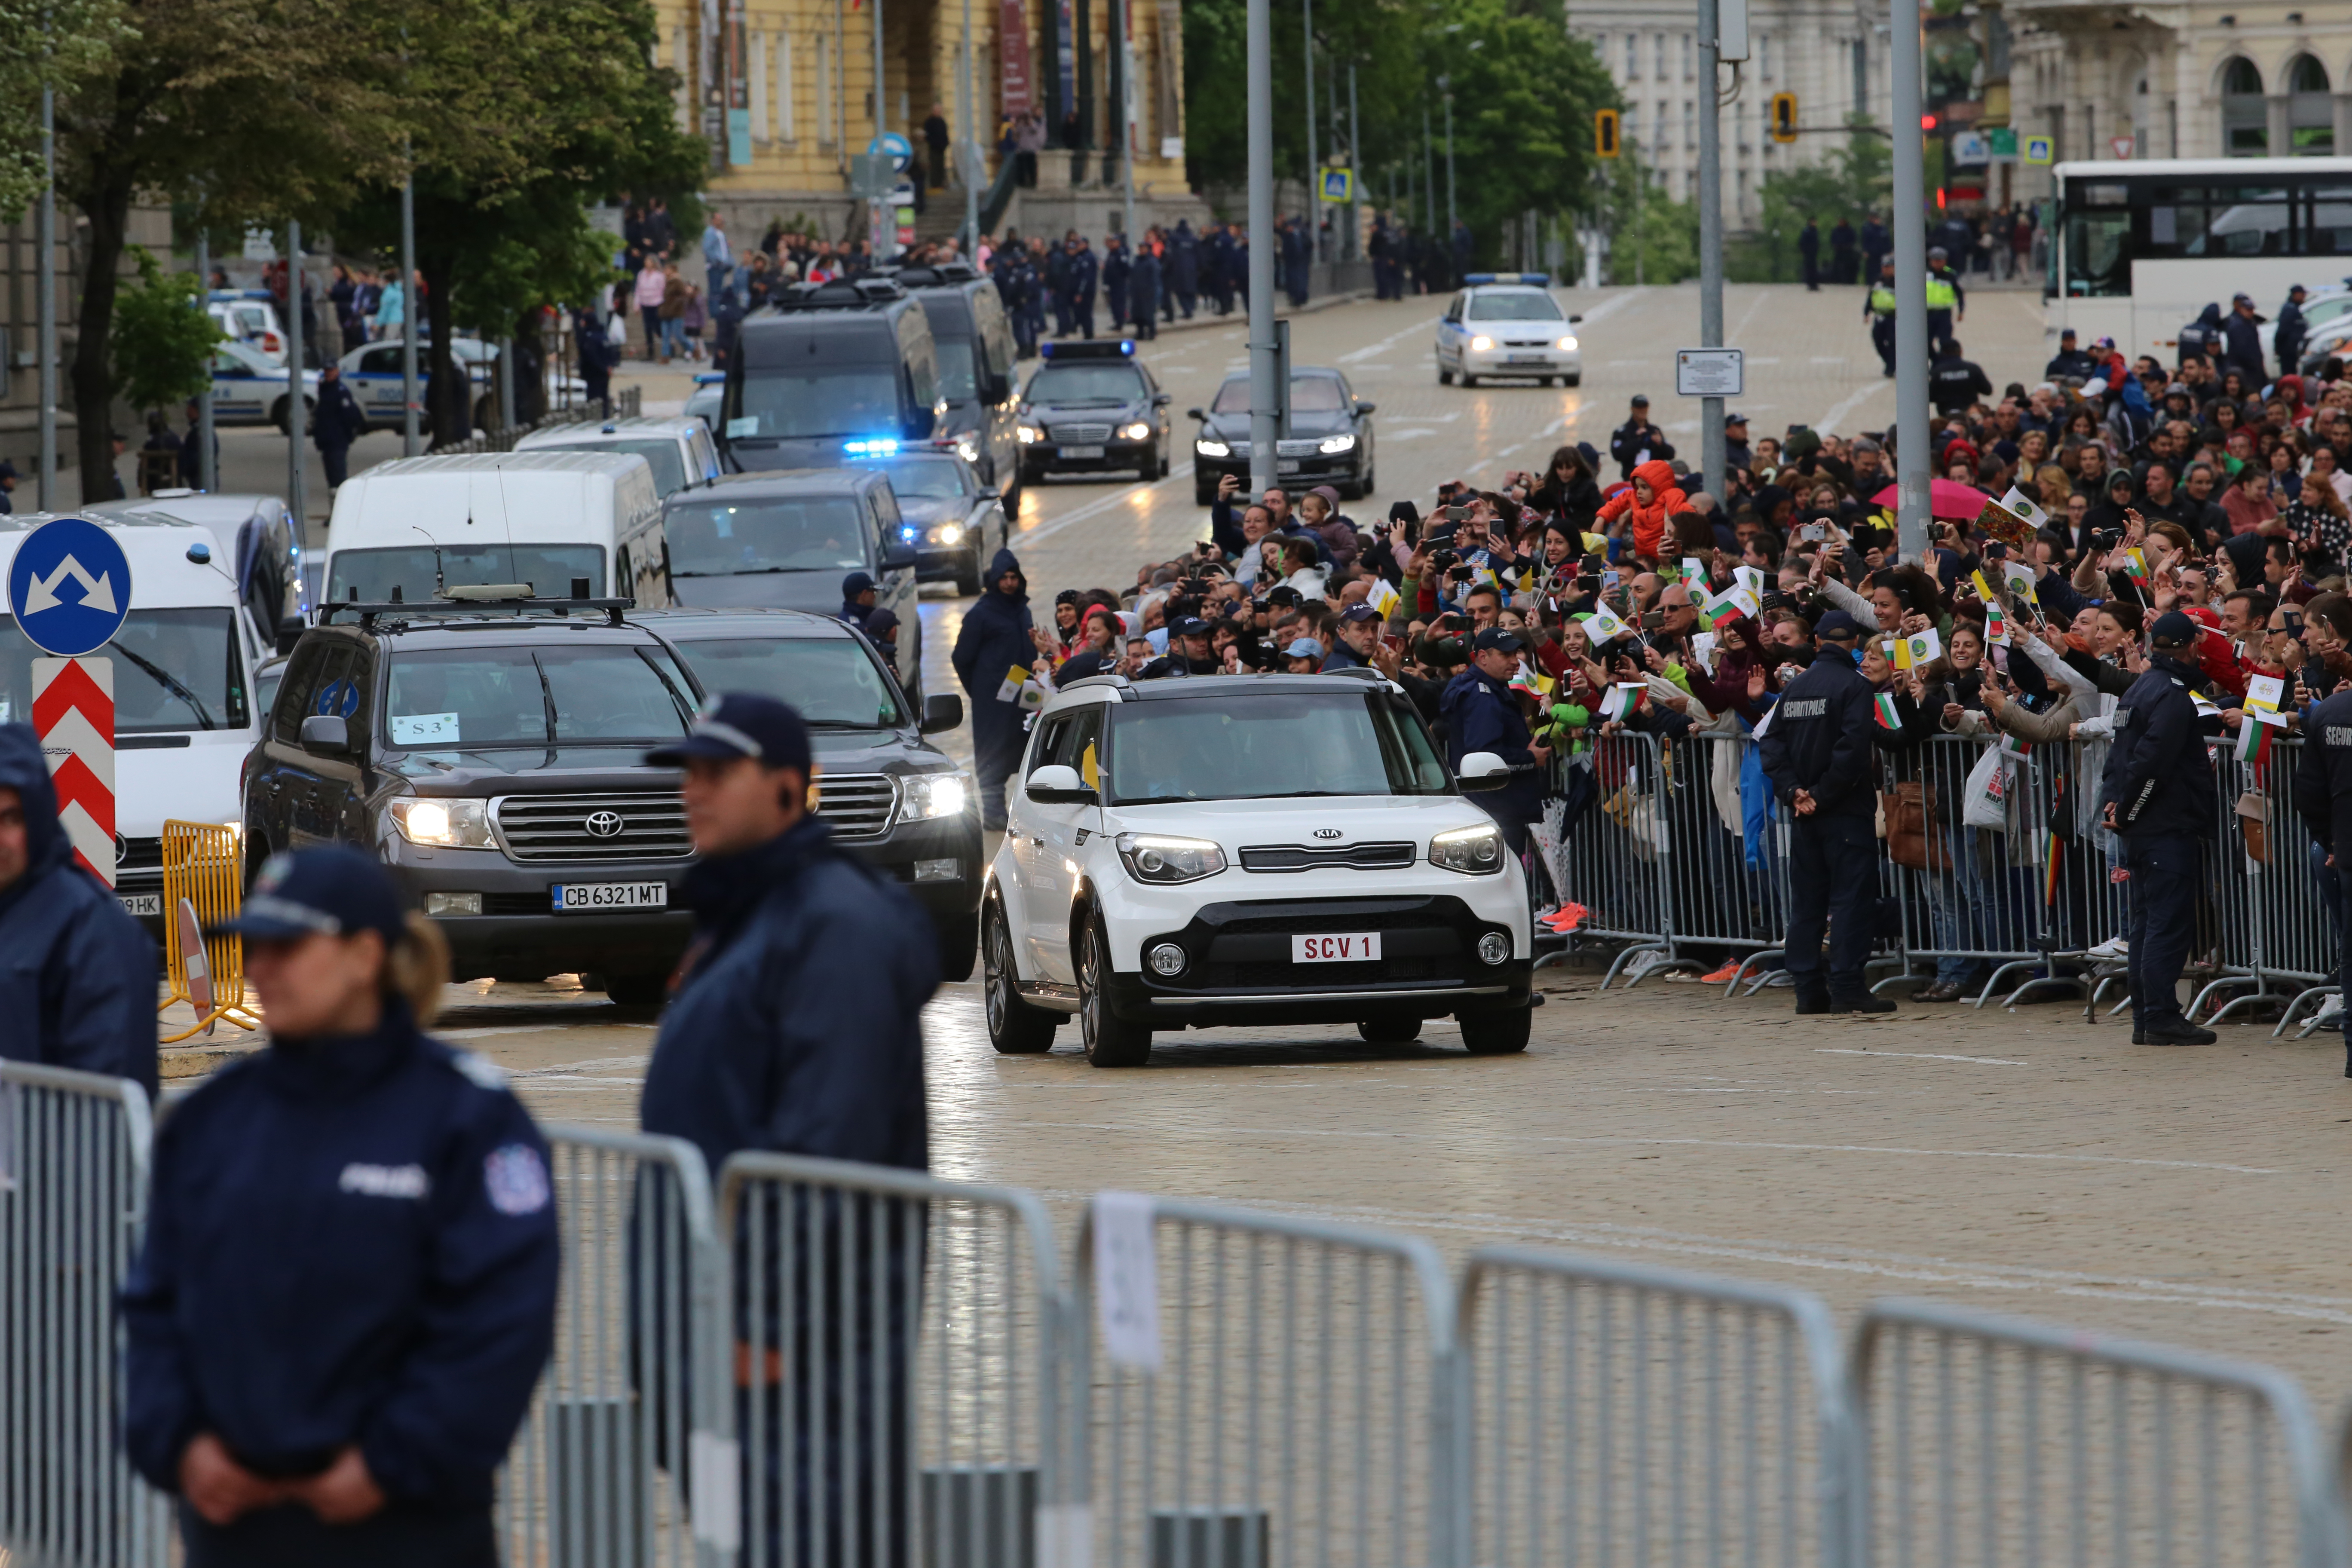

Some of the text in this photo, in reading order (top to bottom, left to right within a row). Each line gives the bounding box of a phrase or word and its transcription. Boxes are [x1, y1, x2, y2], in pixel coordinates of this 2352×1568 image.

[1783, 699, 1826, 717] SECURITY POLICE
[413, 722, 441, 734] S 3
[2326, 726, 2352, 746] SECUR
[137, 897, 156, 913] HK
[565, 885, 662, 906] CB 6321 MT
[1305, 937, 1369, 959] S.C.V. 1
